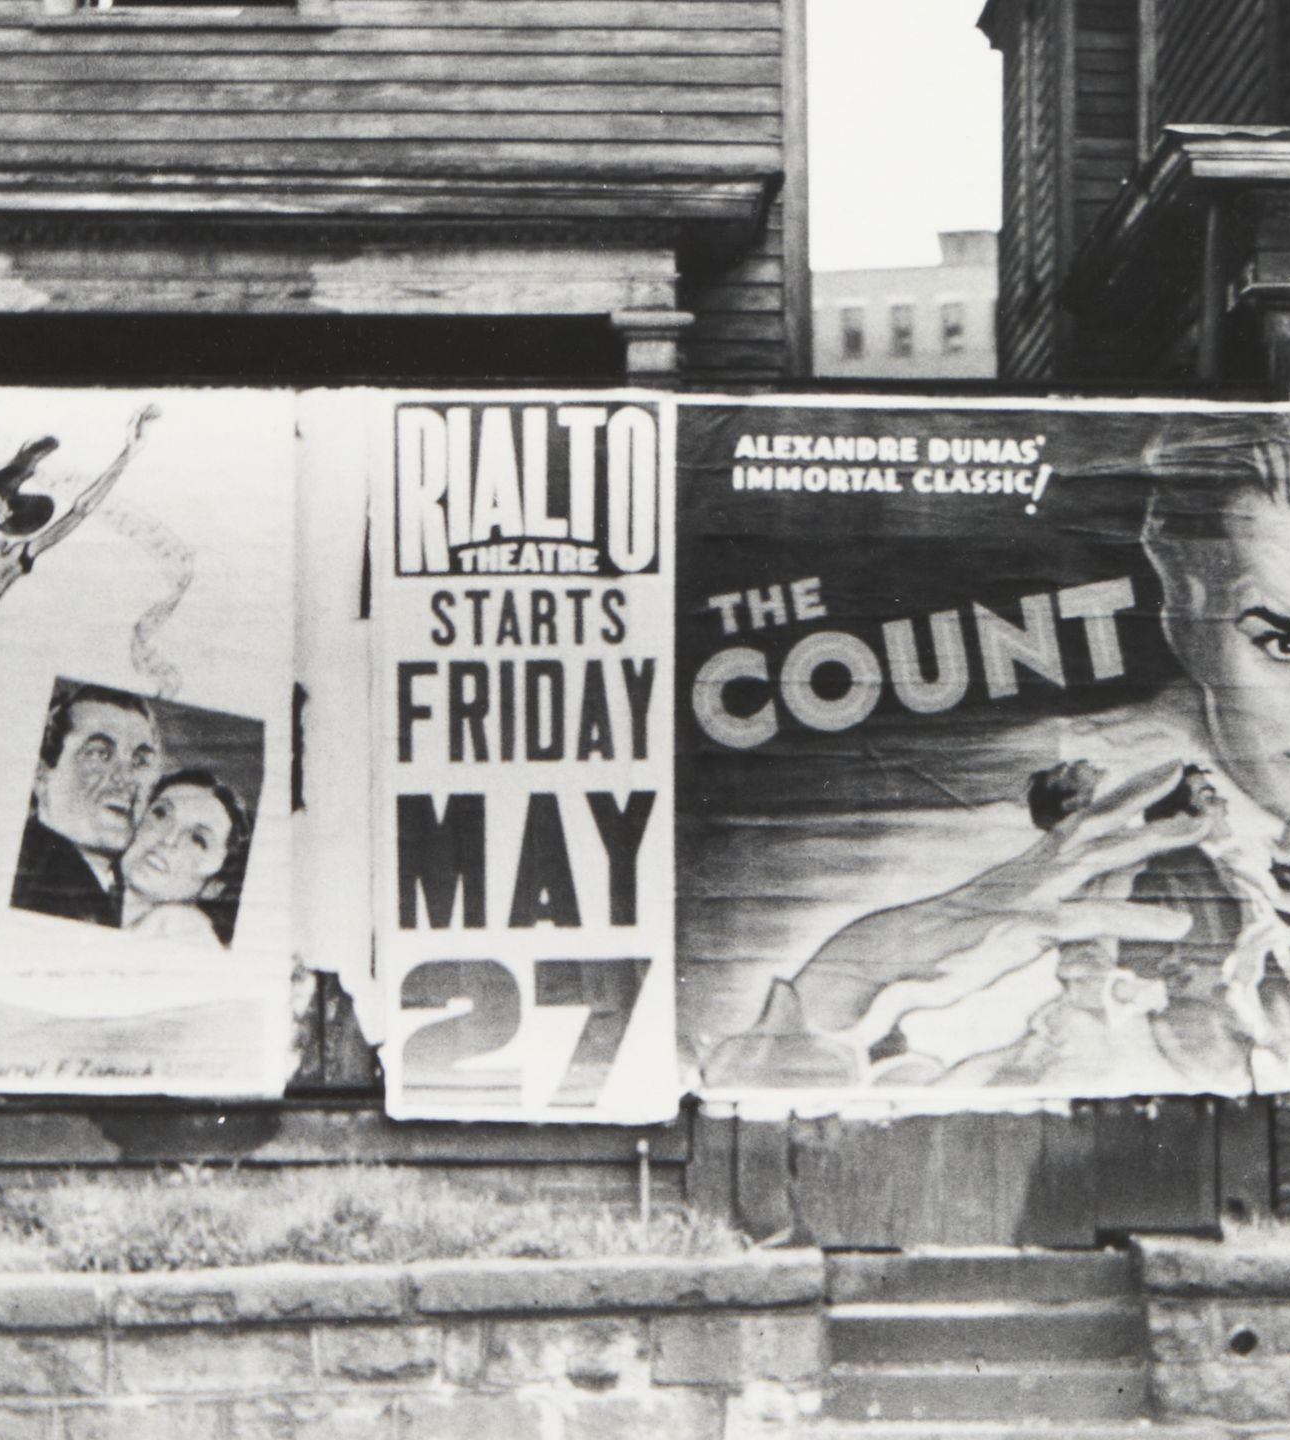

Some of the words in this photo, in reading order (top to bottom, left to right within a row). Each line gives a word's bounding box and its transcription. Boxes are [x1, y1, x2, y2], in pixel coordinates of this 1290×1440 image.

[396, 406, 656, 573] RIALTO
[732, 466, 903, 493] IMMORTAL
[913, 464, 1053, 515] CLASSIC!
[733, 434, 918, 463] ALEXANDRE
[928, 435, 1046, 464] DUMAS'
[457, 543, 600, 573] THEATRE
[430, 589, 628, 647] STARTS
[708, 576, 828, 636] THE
[692, 576, 1135, 750] COUNT
[397, 658, 657, 763] FRIDAY
[397, 790, 658, 930] MAY
[400, 959, 653, 1108] 27
